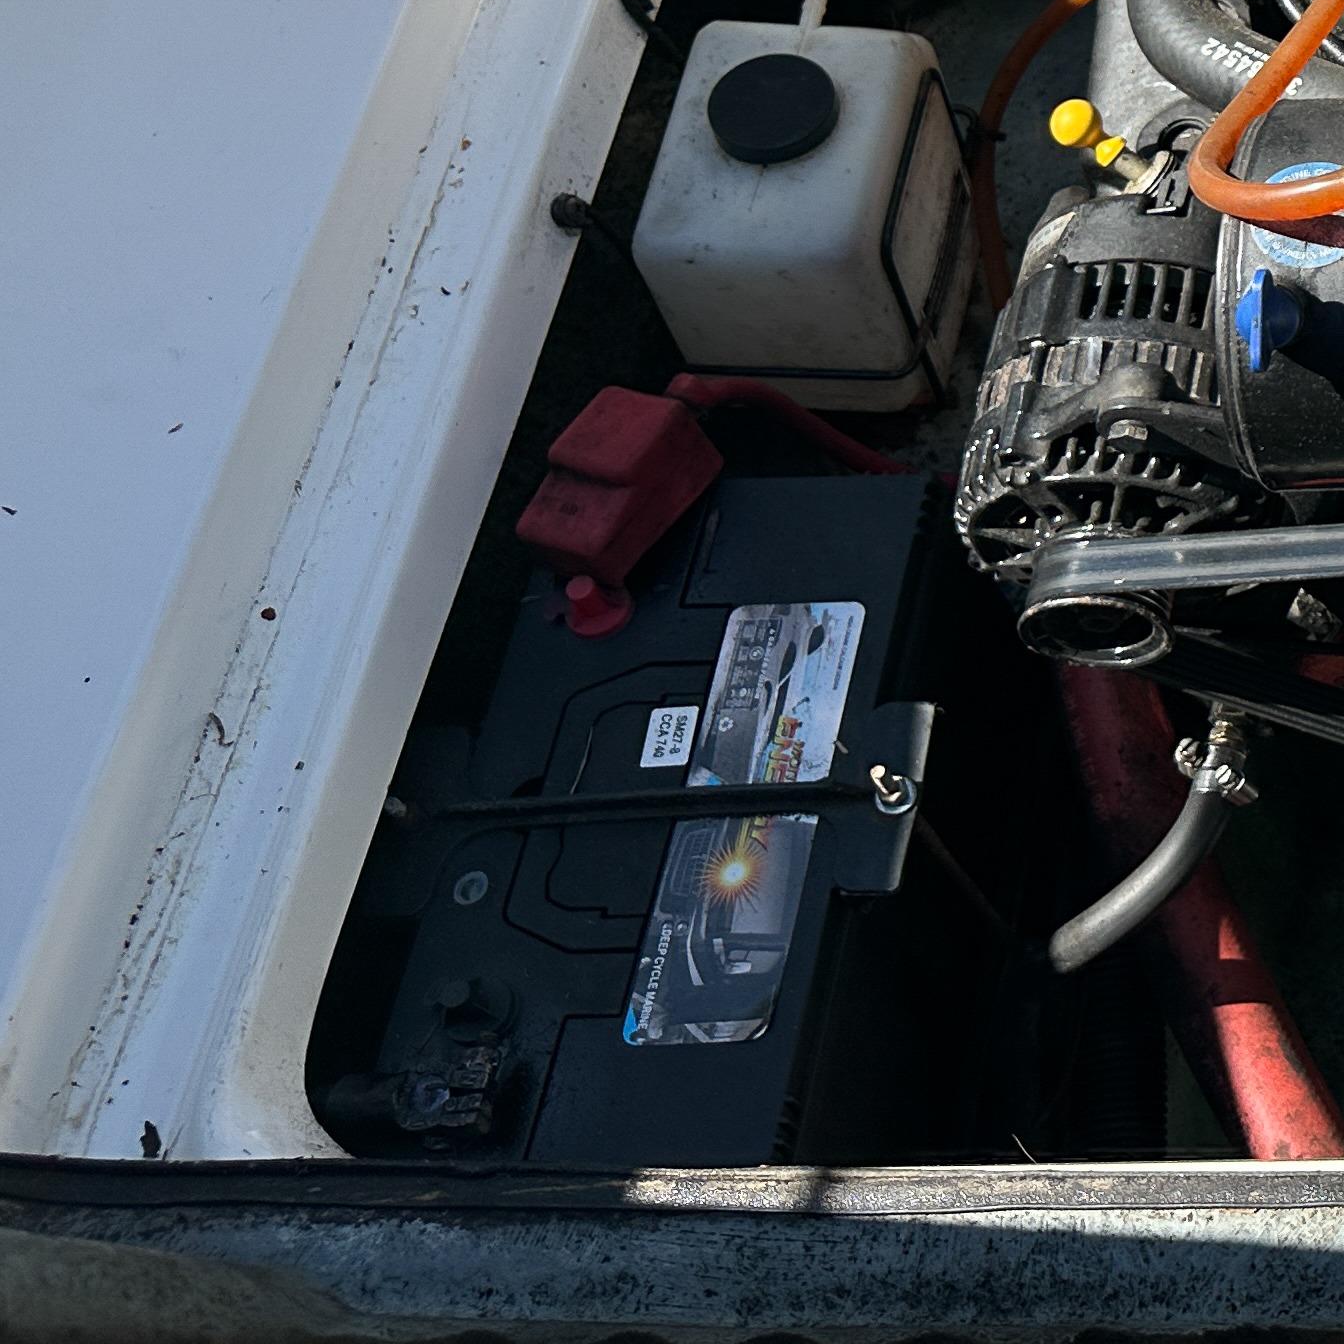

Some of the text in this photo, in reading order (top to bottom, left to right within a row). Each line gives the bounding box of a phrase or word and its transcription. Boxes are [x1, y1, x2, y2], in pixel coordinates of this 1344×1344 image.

[657, 713, 672, 737] CCA
[636, 927, 672, 1030] DEEP CYCLE MARINE
